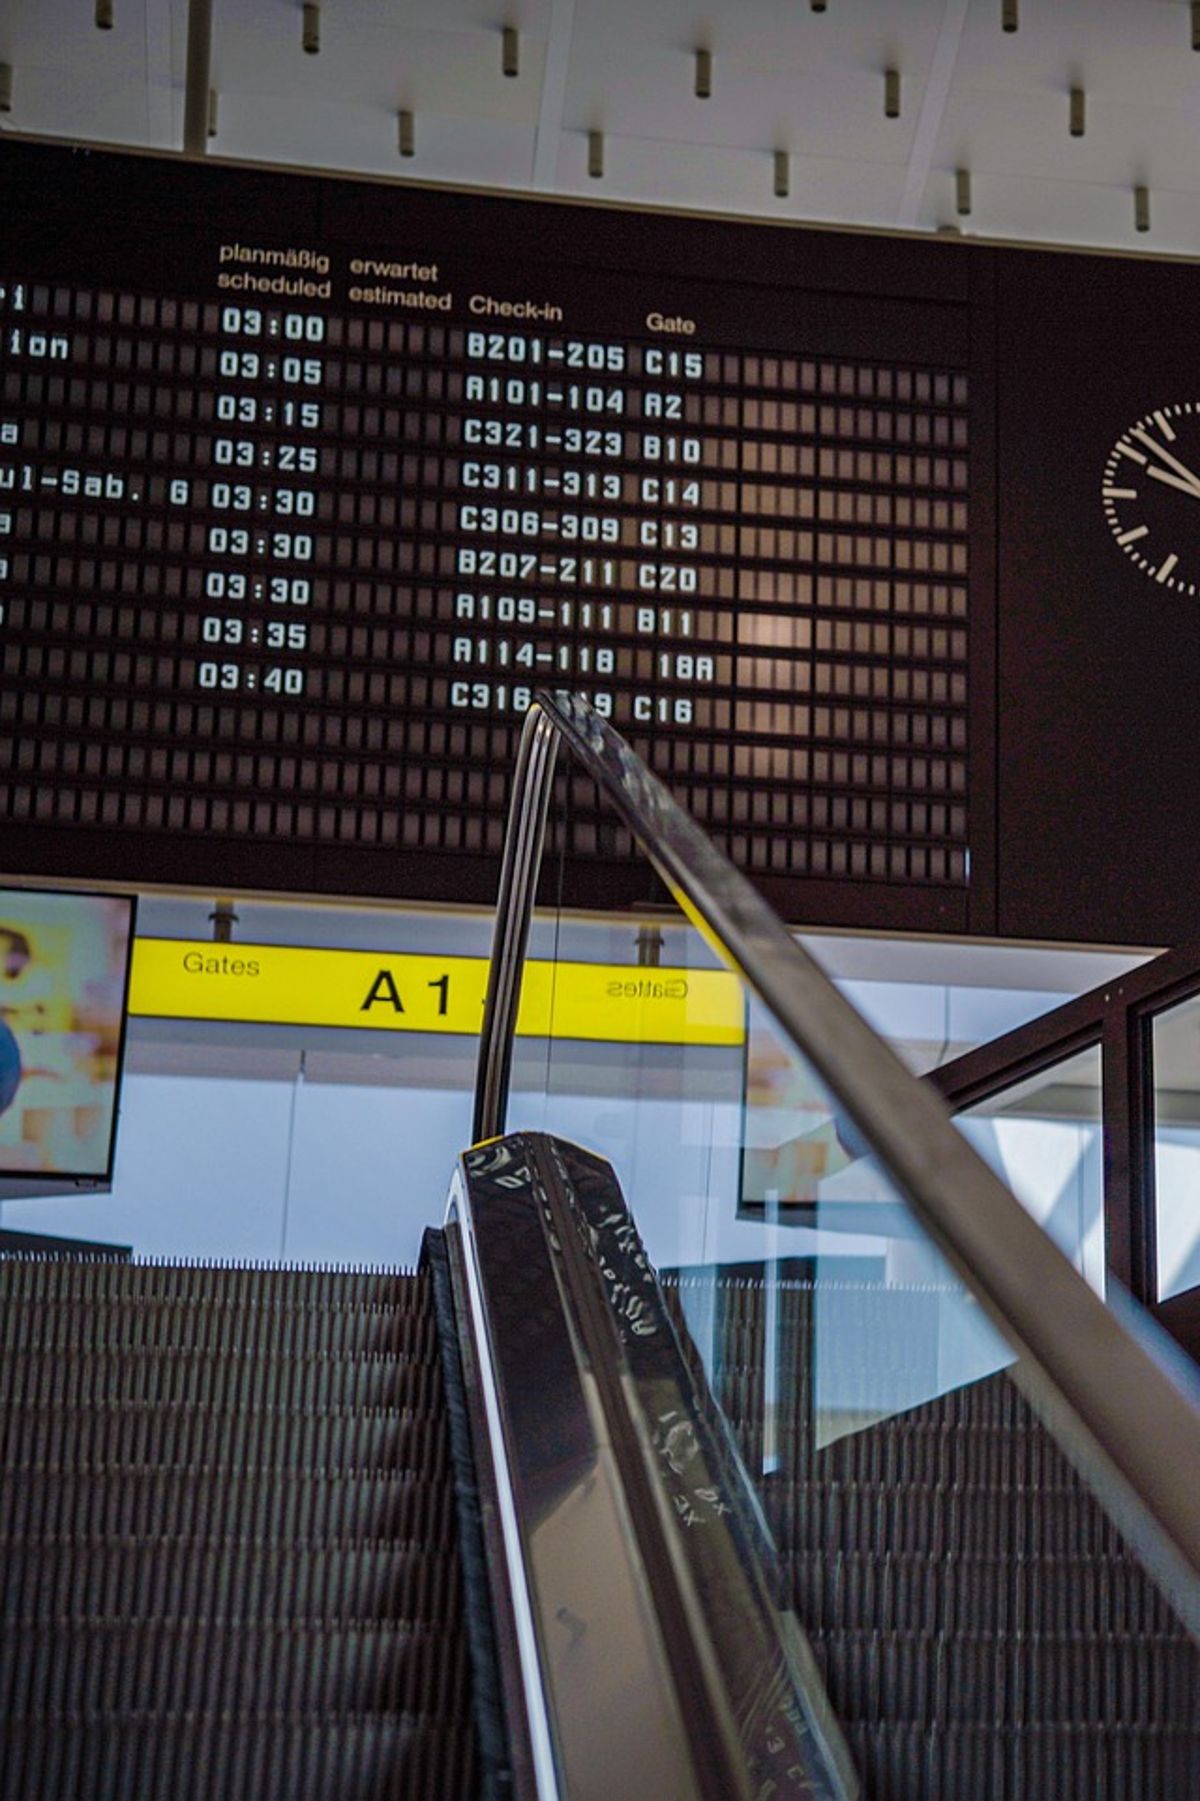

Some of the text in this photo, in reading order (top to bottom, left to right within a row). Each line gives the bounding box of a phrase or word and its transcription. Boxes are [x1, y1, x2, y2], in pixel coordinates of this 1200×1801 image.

[218, 243, 331, 274] planmäßig
[349, 259, 438, 282] erwartet
[217, 271, 332, 299] scheduled
[348, 286, 452, 311] estimated
[469, 294, 563, 321] Check-in
[645, 312, 696, 335] Gate
[222, 307, 324, 342] 03:00
[468, 332, 624, 371] B201-205
[645, 349, 702, 379] C15
[220, 351, 322, 385] 03:05
[466, 375, 624, 414] A101-104
[644, 392, 682, 420] A2
[217, 395, 319, 428] 03:15
[464, 419, 622, 456] C321-323
[643, 435, 700, 464] B10
[215, 439, 317, 472] 03:25
[462, 462, 621, 500] C311-313
[642, 477, 699, 507] C14
[212, 483, 314, 516] 03:30
[460, 505, 619, 543] C306-309
[640, 520, 698, 550] C13
[209, 527, 312, 560] 03:30
[458, 549, 614, 586] B207-211
[639, 563, 697, 593] C20
[206, 572, 309, 605] 03:30
[456, 593, 612, 630] A109-111
[637, 607, 692, 637] B11
[203, 617, 306, 649] 03:35
[453, 637, 614, 674] A114-118
[659, 653, 714, 682] 18A
[199, 662, 303, 694] 03:40
[451, 681, 612, 718] C3169
[634, 695, 692, 724] C16
[183, 952, 450, 1015] Gates A 1
